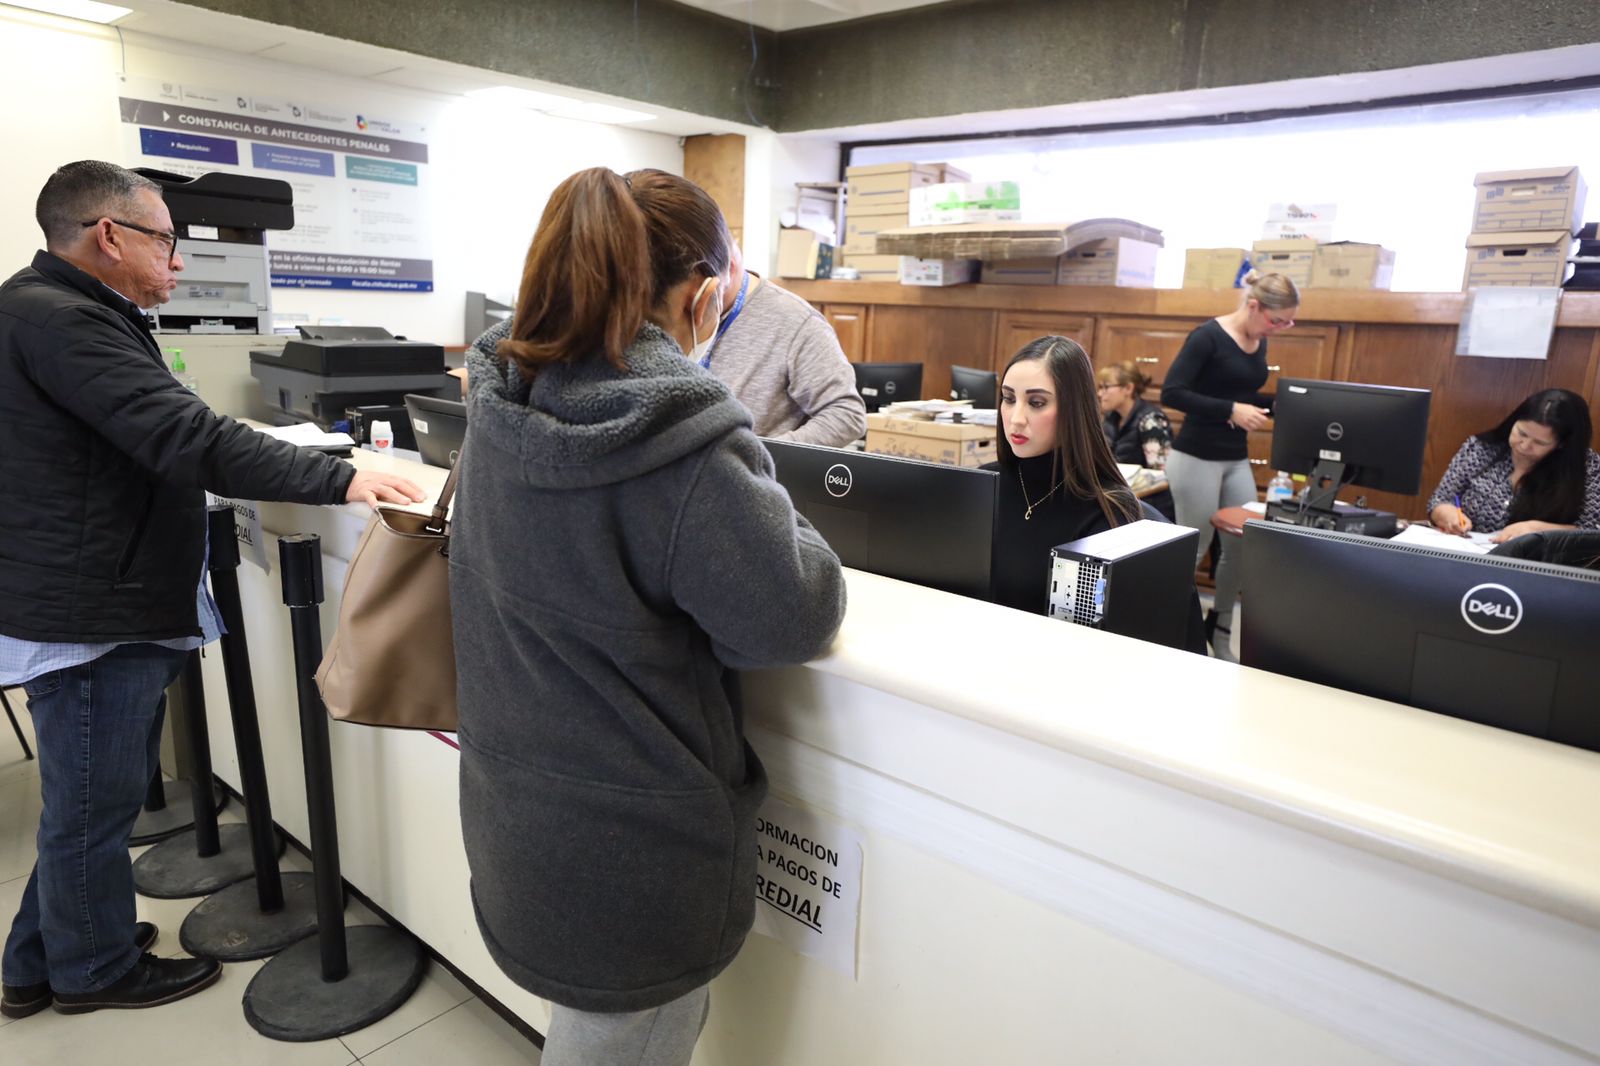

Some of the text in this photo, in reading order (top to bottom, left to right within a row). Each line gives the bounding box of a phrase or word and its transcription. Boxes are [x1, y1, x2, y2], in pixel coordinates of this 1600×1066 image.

[178, 114, 391, 154] CONSTANCIA DE ANTECEDENTES PENALES
[292, 255, 316, 263] oficina
[828, 474, 849, 487] DELL
[249, 508, 256, 521] DE
[1468, 599, 1515, 620] DELL
[767, 849, 817, 886] PAGOS
[822, 876, 842, 899] DE
